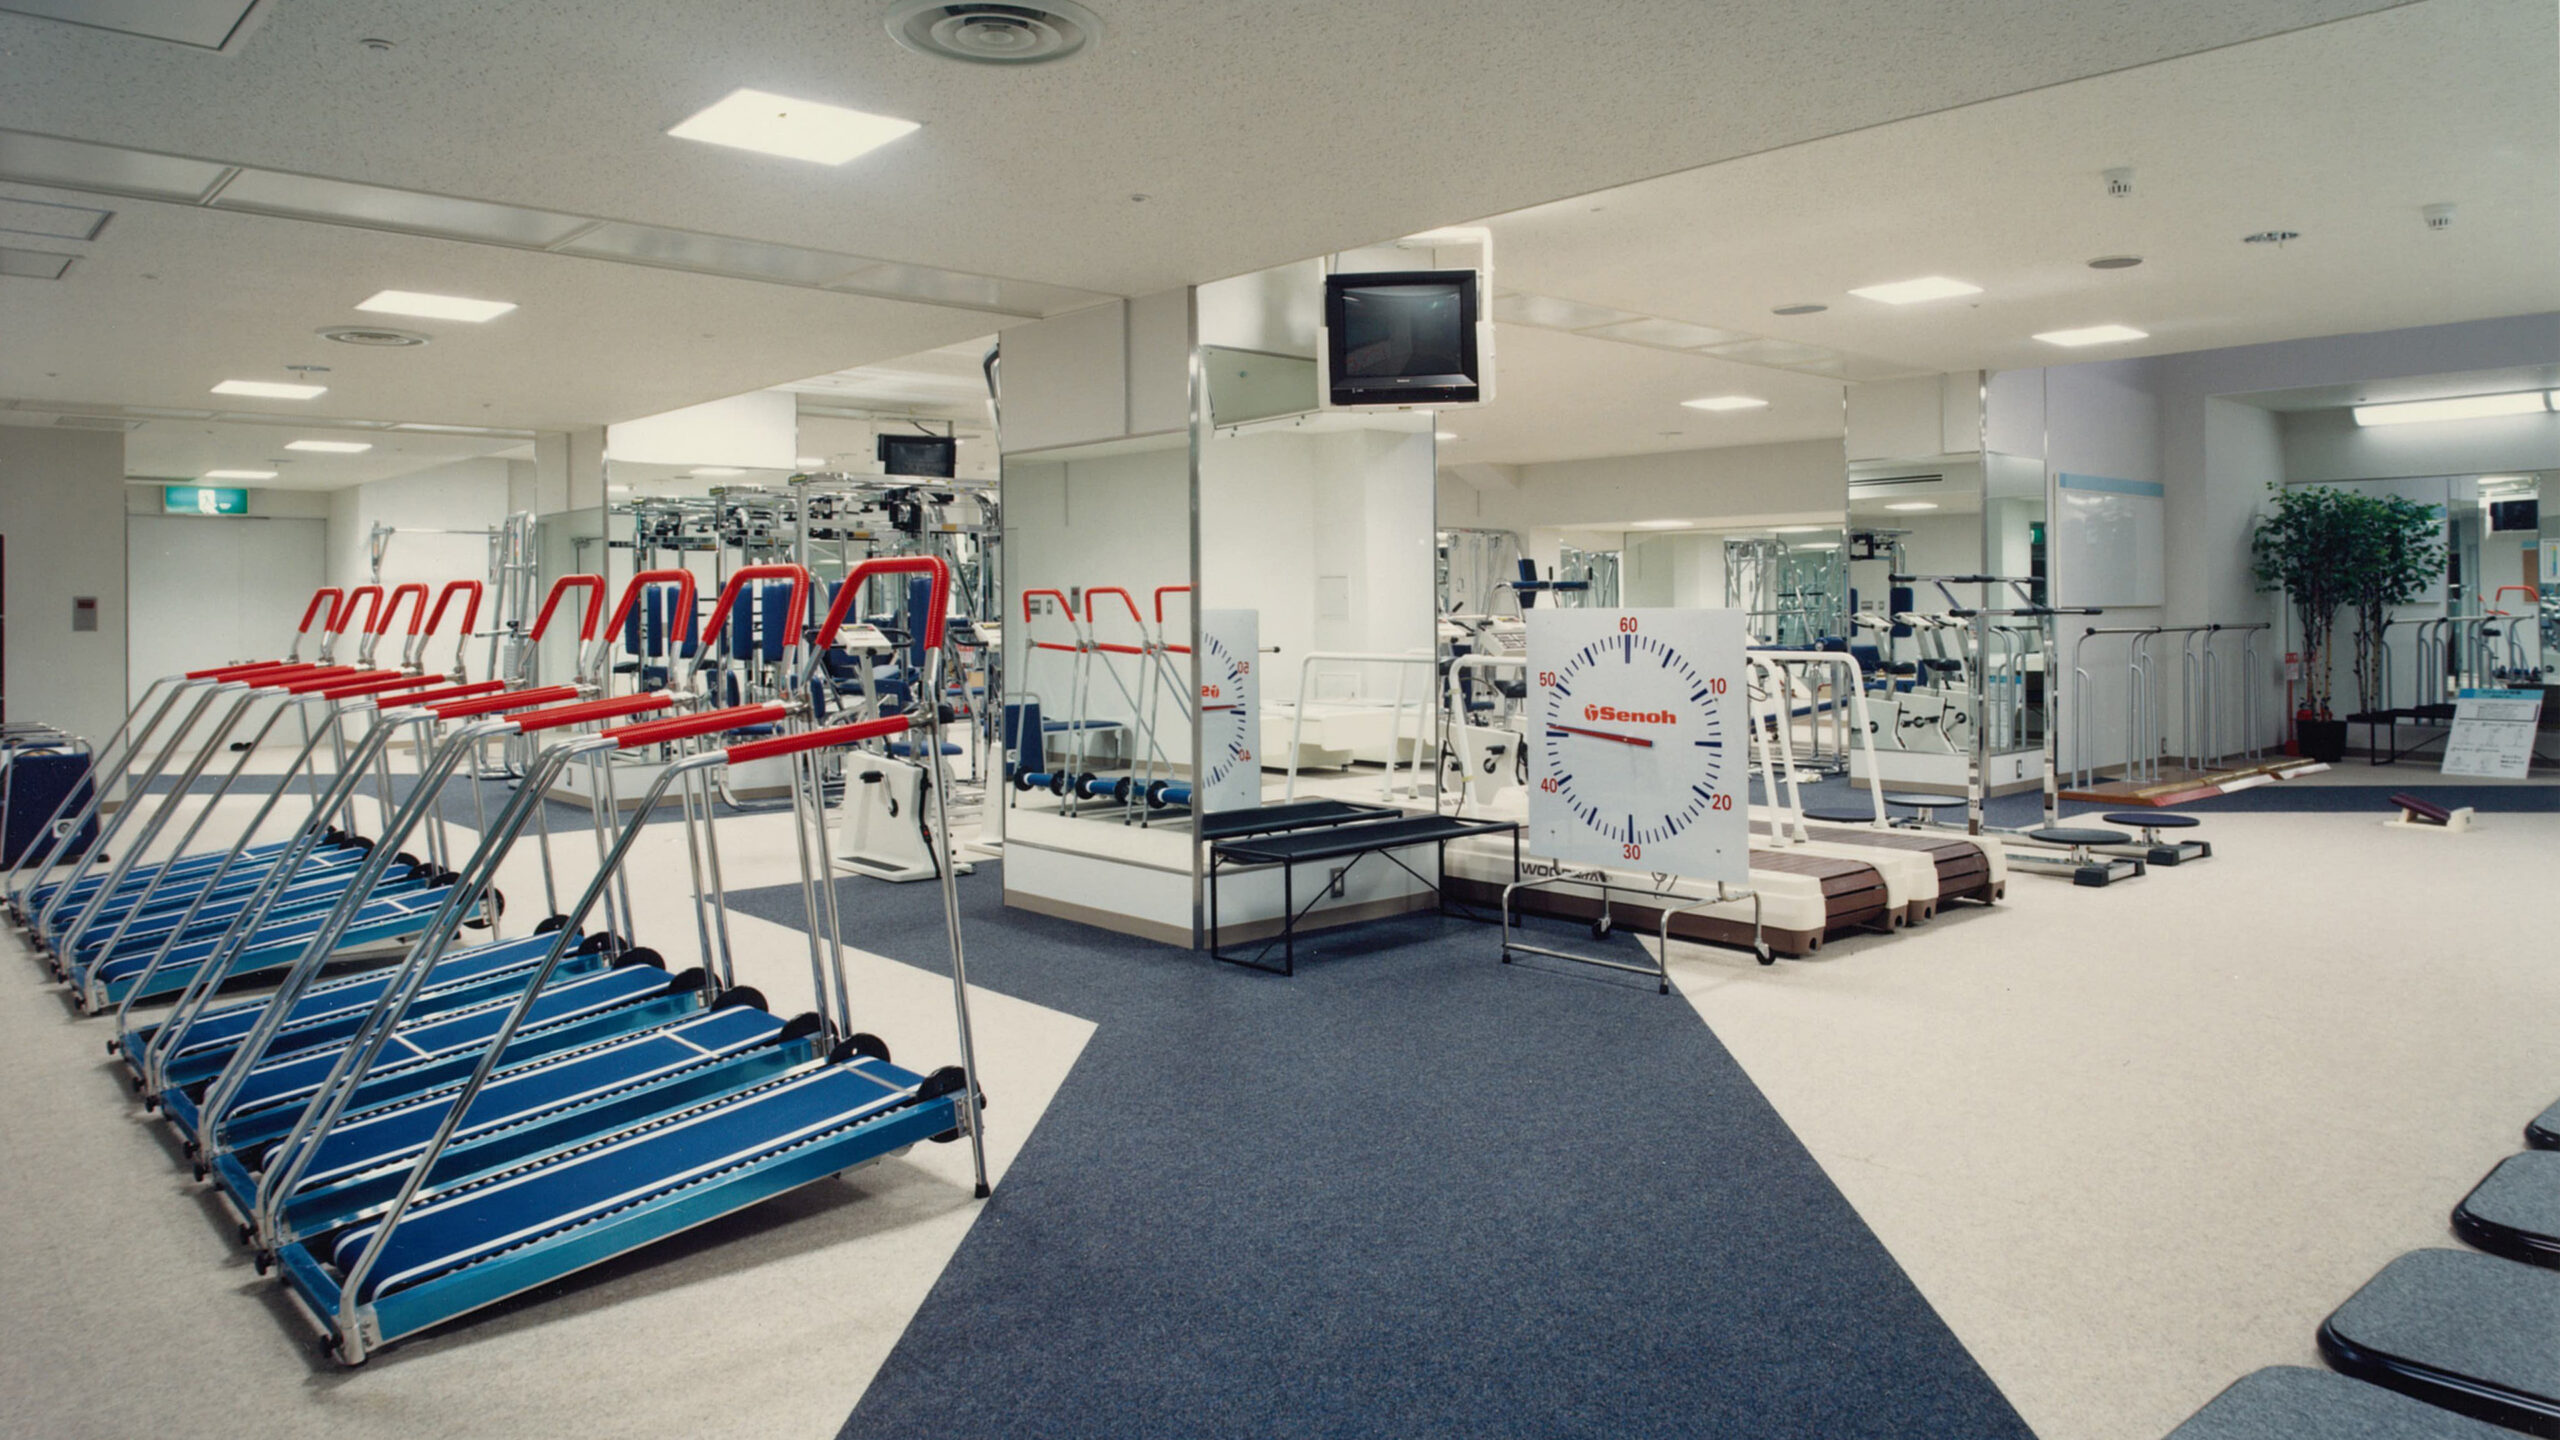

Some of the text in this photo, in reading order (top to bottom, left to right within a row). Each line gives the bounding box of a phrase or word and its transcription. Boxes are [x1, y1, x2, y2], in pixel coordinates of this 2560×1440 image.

[1619, 617, 1638, 633] 60
[1539, 672, 1556, 687] 50
[1709, 678, 1727, 694] 10
[1600, 706, 1677, 725] Senoh
[1540, 778, 1558, 793] 40
[1711, 794, 1732, 811] 20
[1622, 844, 1641, 860] 30
